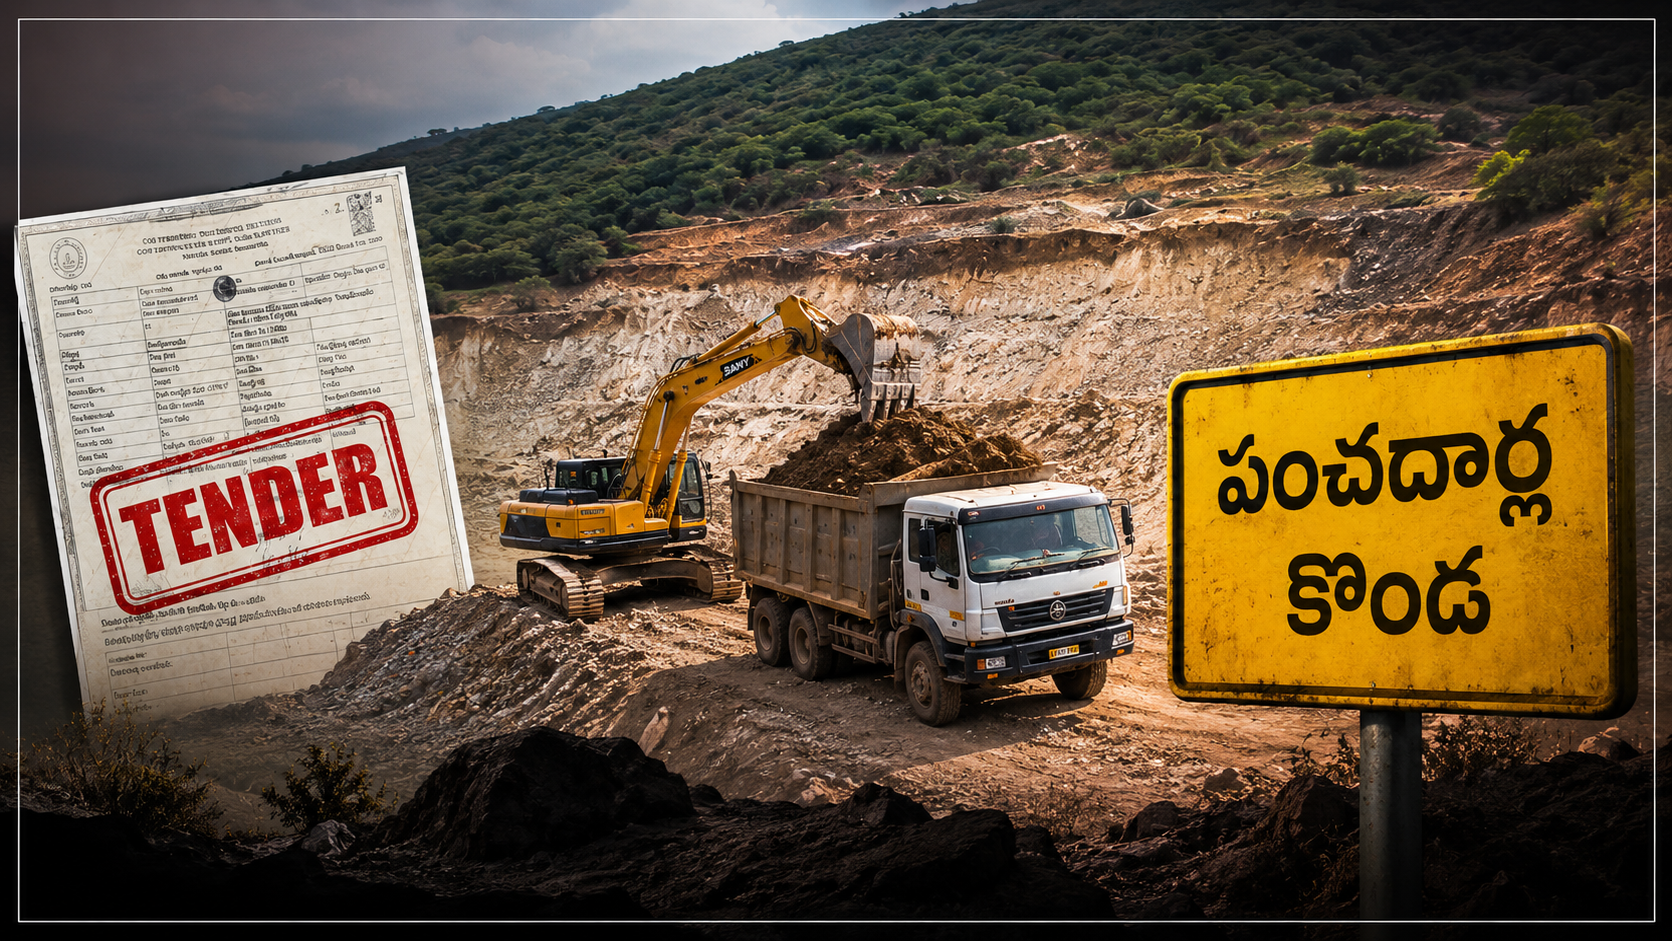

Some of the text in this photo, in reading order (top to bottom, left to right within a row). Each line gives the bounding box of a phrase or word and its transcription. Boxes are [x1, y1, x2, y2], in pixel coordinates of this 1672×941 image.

[118, 442, 389, 575] TENDER
[1218, 403, 1552, 527] పంచదార్ల
[1287, 545, 1491, 636] కొండ
